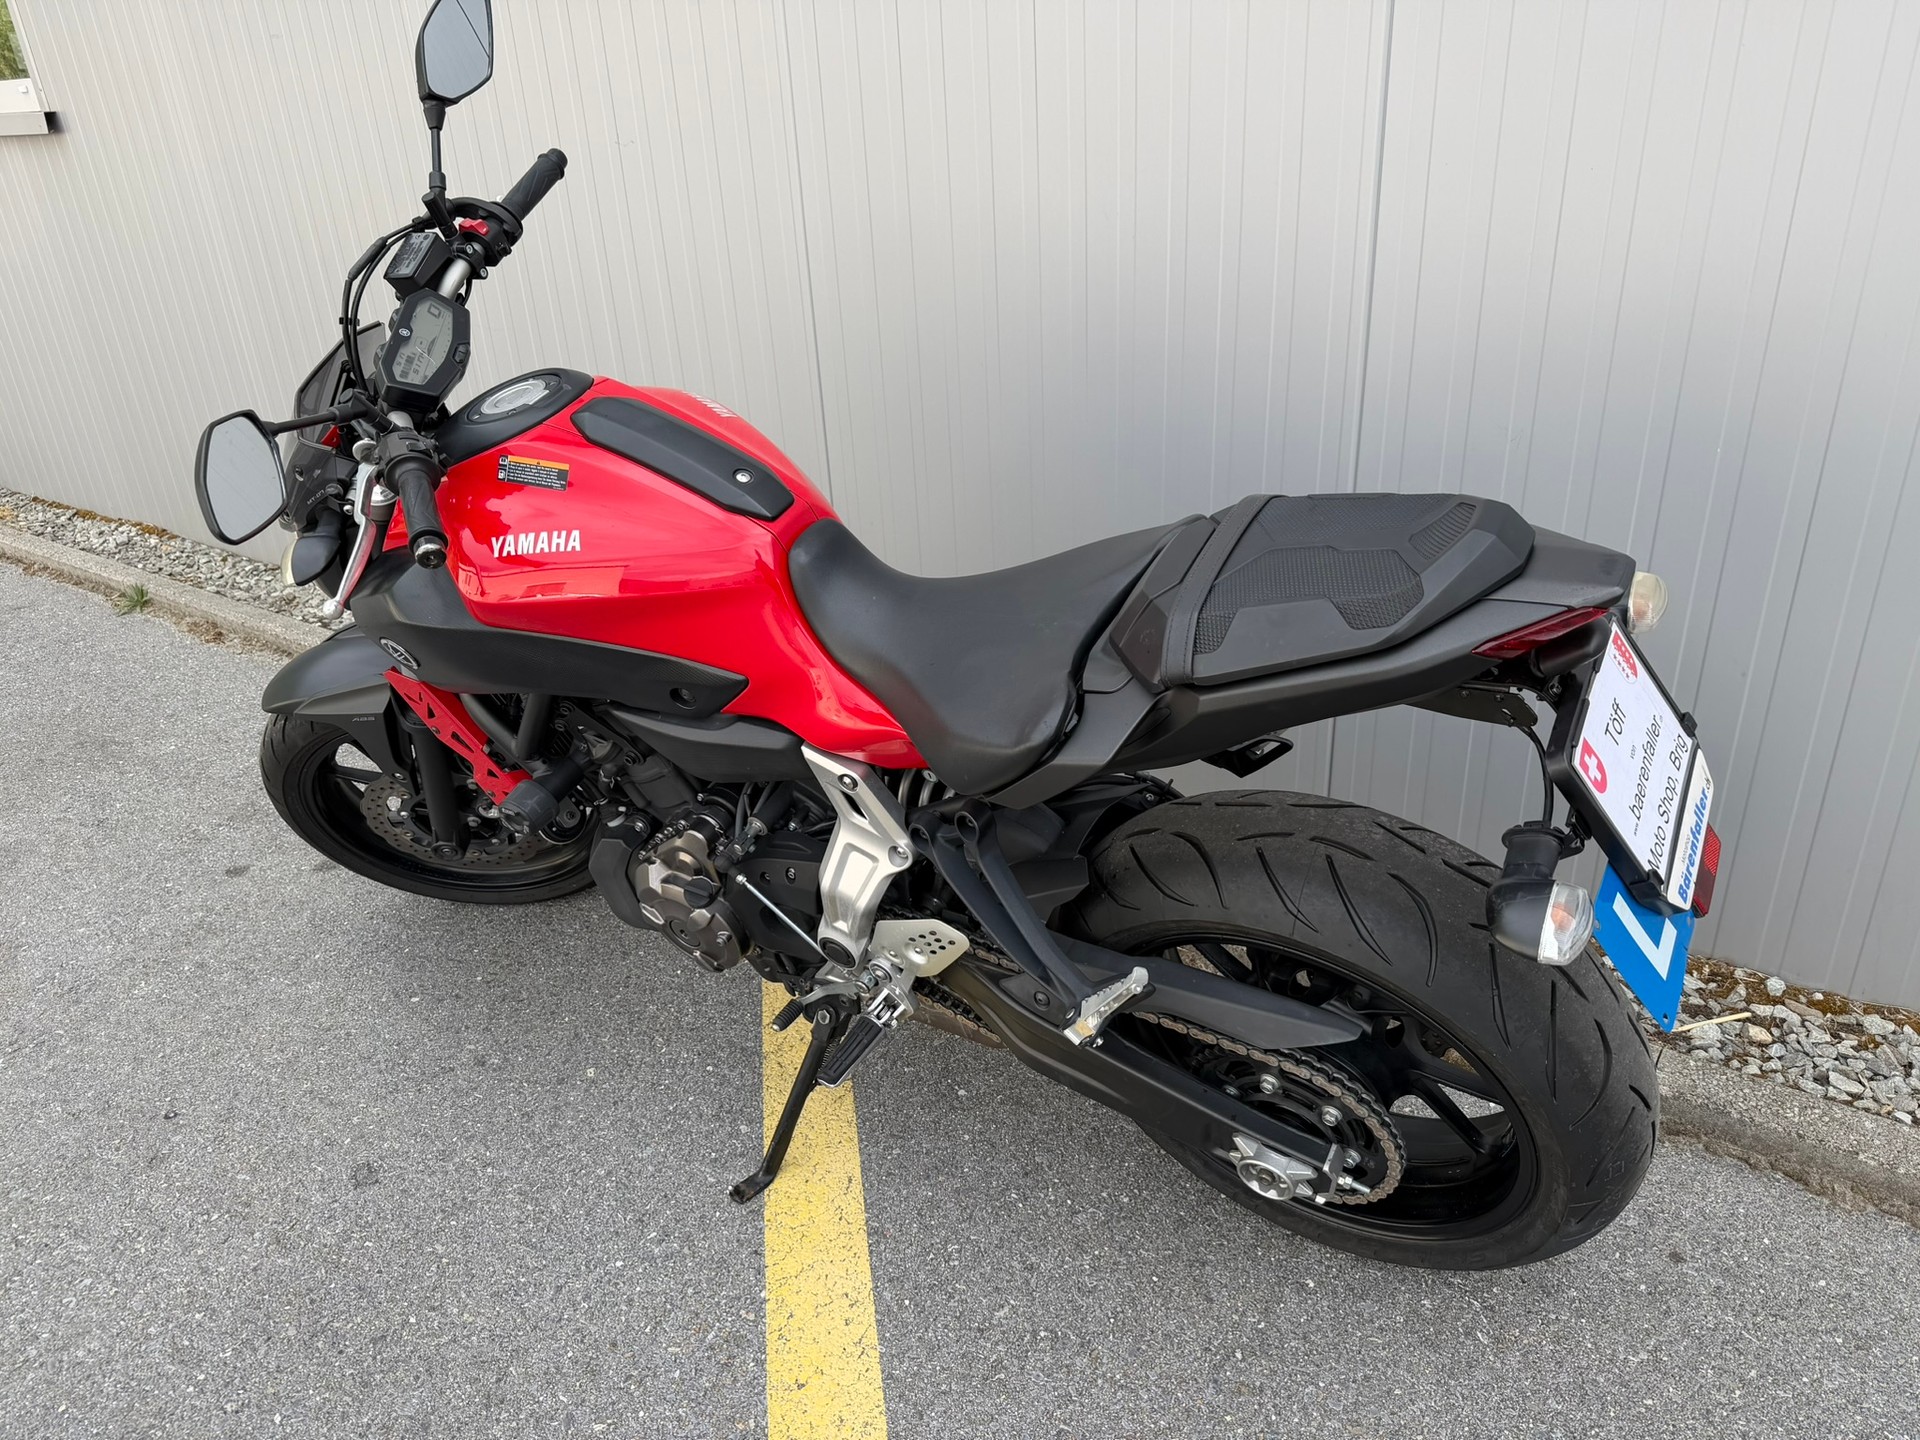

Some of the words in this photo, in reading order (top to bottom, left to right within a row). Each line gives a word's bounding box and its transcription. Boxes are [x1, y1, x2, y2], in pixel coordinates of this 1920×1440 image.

[491, 529, 581, 558] YAMAHA
[1604, 697, 1627, 746] Töff
[1668, 733, 1689, 771] Brig
[1657, 775, 1680, 824] Shop,
[1647, 825, 1666, 870] Moto
[1612, 891, 1677, 982] L
